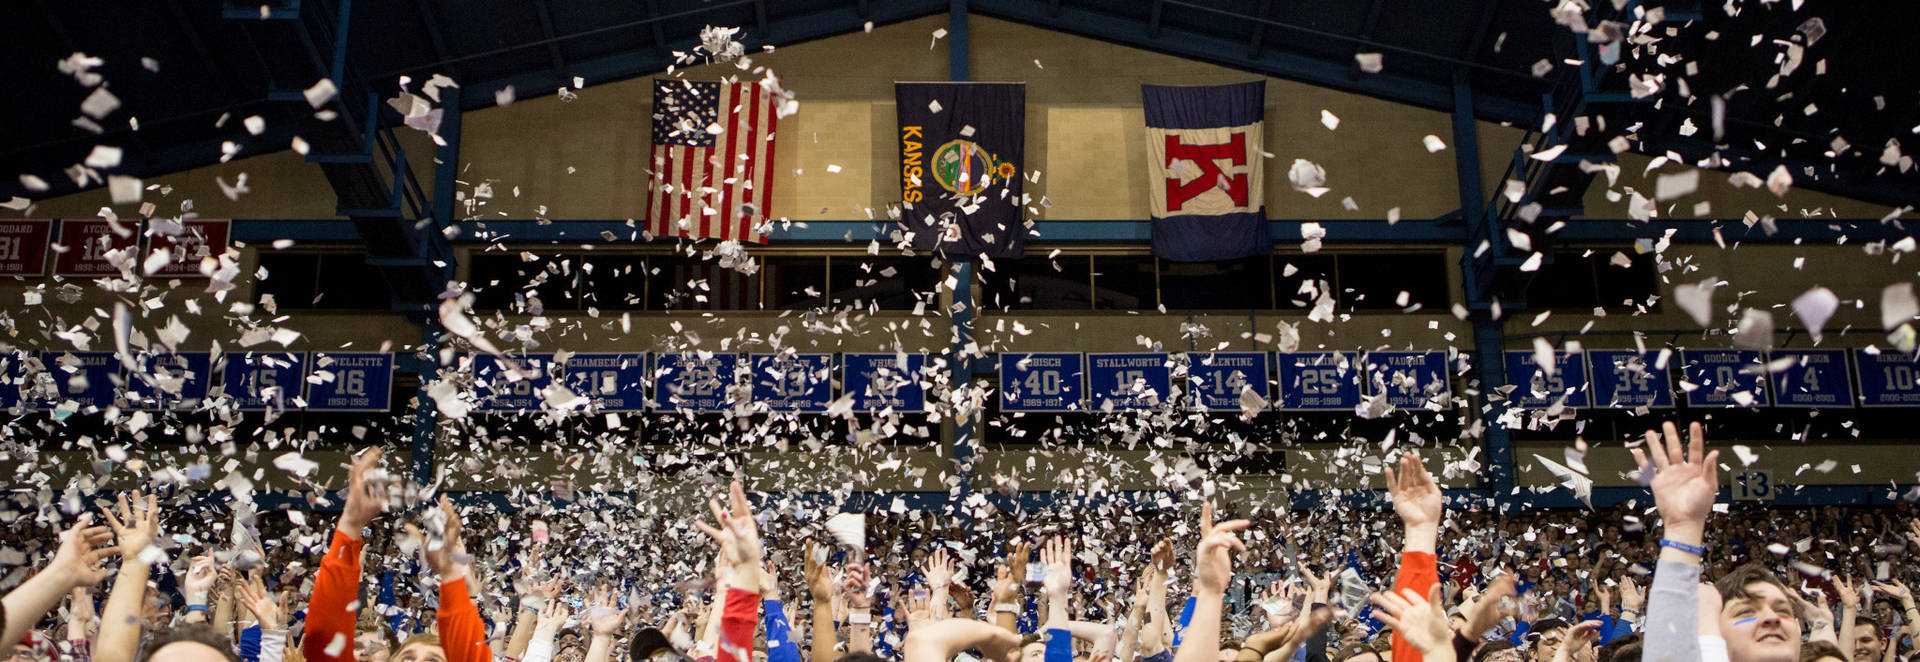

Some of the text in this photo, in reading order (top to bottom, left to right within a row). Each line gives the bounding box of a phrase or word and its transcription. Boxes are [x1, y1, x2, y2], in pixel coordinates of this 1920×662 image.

[1165, 132, 1248, 212] K
[83, 225, 118, 234] AYCOC
[0, 237, 21, 260] 31
[322, 358, 383, 366] VELLETTE
[571, 359, 638, 367] CHAMBERLIN
[1023, 358, 1061, 366] OBISCH
[1097, 358, 1160, 367] STALLWORTH
[1201, 358, 1253, 366] LENTINE
[335, 370, 365, 395] 16
[1024, 370, 1060, 395] 40
[1214, 370, 1247, 394] 14
[1302, 370, 1339, 395] 25
[1613, 369, 1649, 392] 34
[1716, 366, 1735, 390] 0
[1804, 366, 1820, 391] 4
[1883, 366, 1913, 391] 10
[1736, 472, 1769, 497] 13
